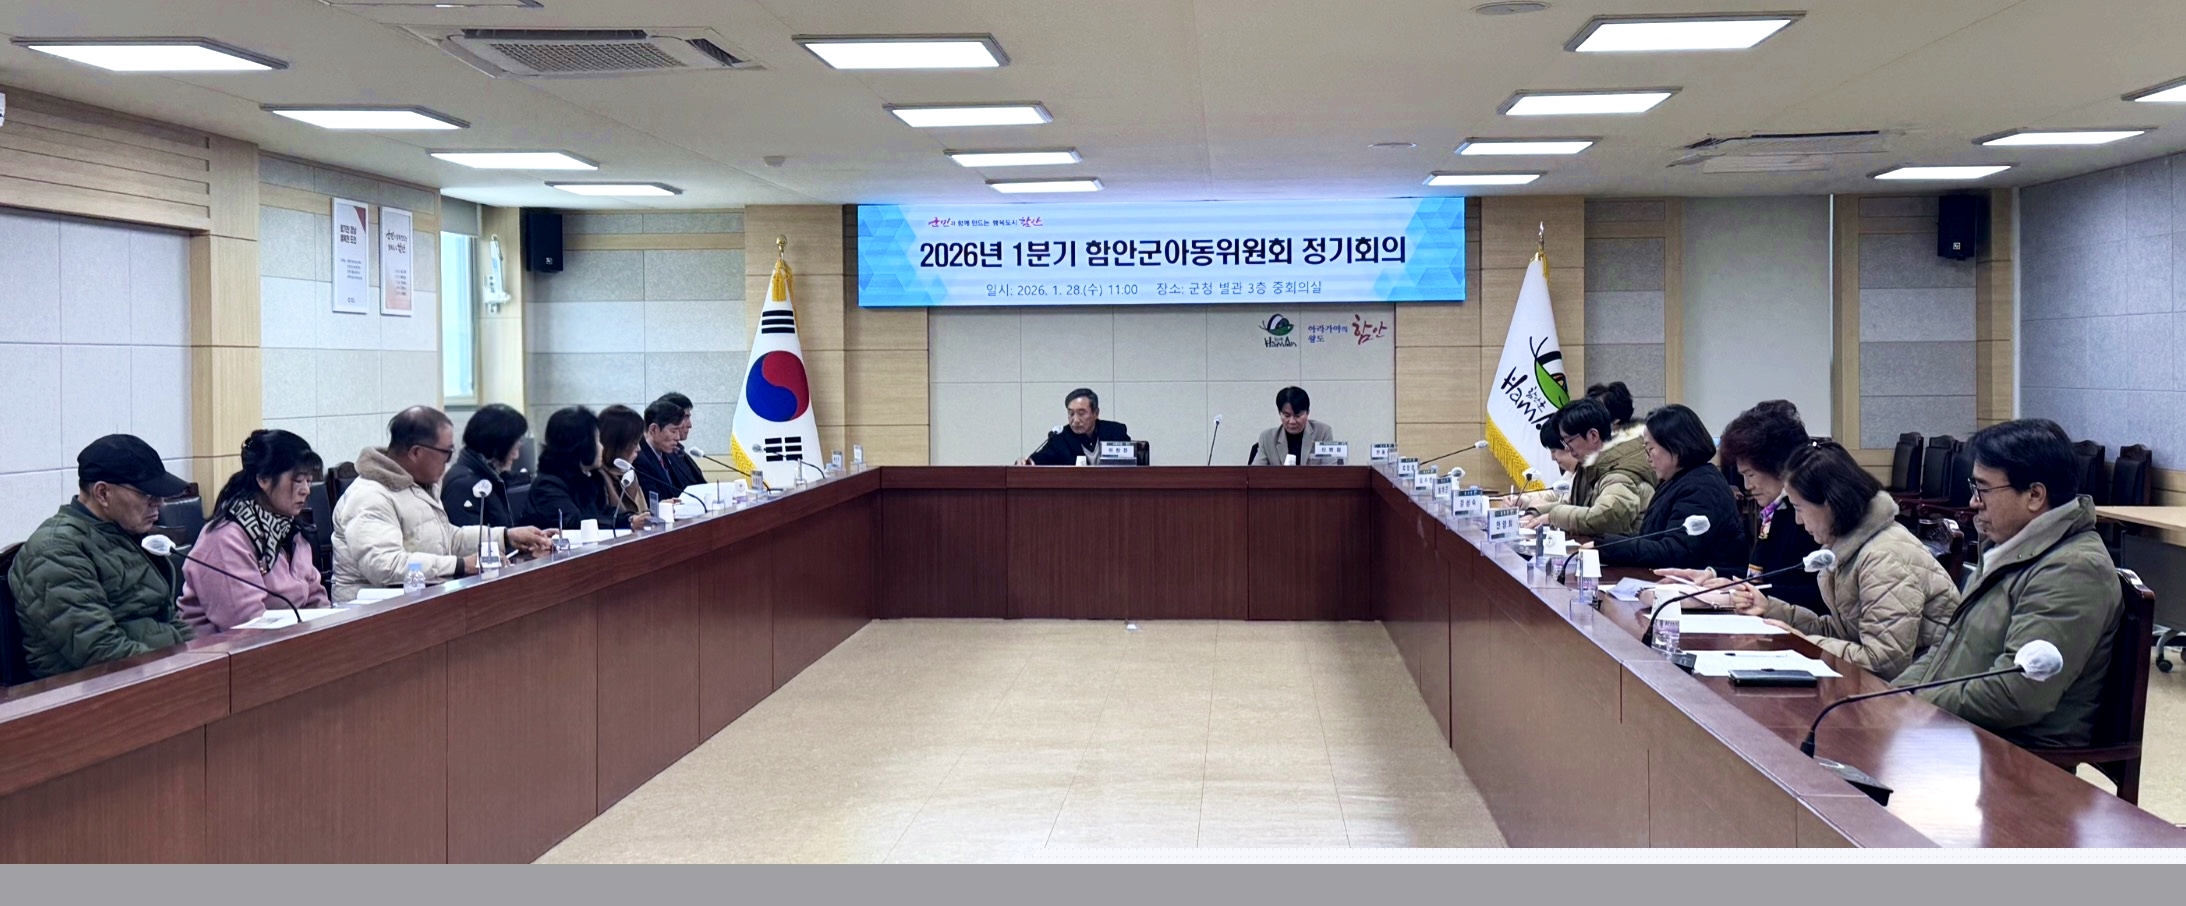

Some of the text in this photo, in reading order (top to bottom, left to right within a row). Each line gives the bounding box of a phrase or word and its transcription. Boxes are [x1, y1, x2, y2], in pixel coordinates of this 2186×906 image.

[993, 219, 1018, 227] 행복도시
[919, 236, 1406, 268] 2026년 1분기 함안군아동위원회 정기회의
[986, 280, 1323, 297] 일시: 2026. 1. 28.(수) 11:00 장소: 군청 별관 3층 중회의실
[1307, 324, 1348, 334] 아라가야의
[1352, 313, 1388, 345] 함안
[1264, 336, 1298, 348] HamAn
[1307, 335, 1325, 344] 왕도
